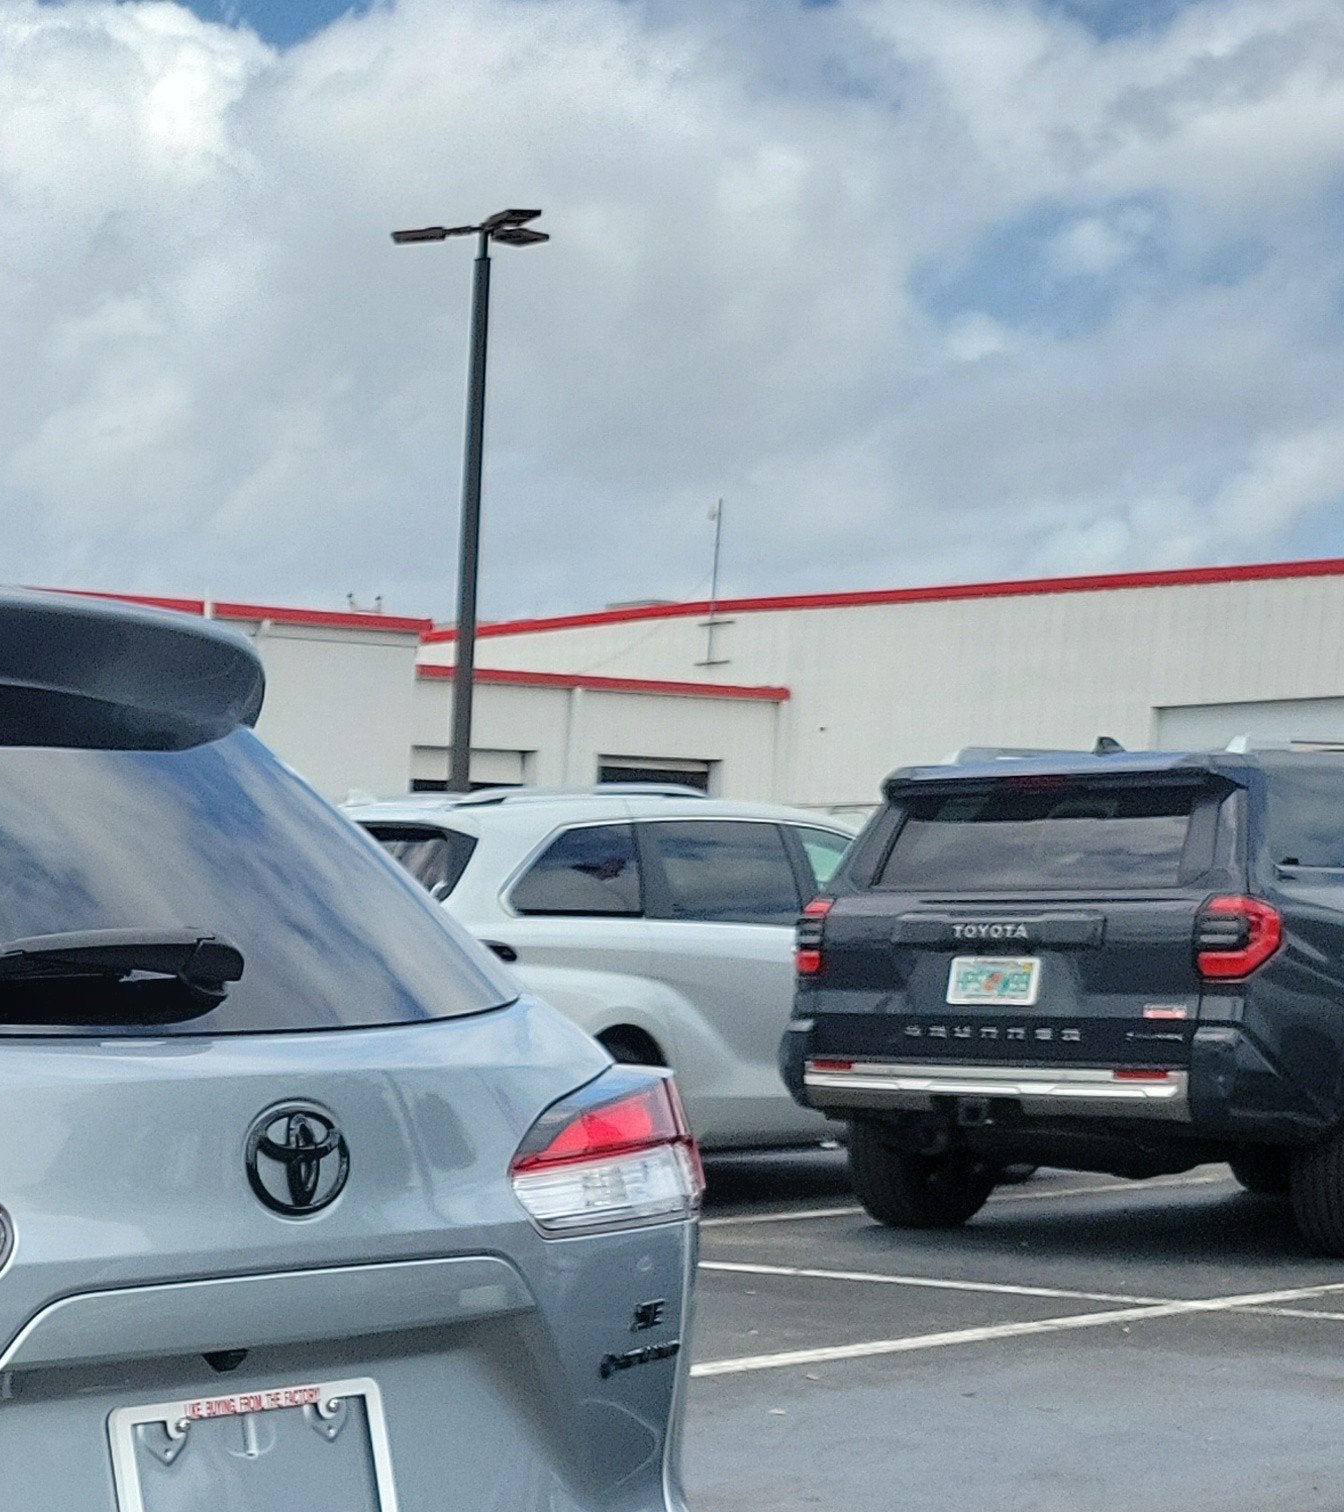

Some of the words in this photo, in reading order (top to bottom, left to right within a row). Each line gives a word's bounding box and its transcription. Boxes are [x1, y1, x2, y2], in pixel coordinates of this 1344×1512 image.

[952, 923, 1029, 939] TOYOTA
[239, 1395, 263, 1411] FROM
[266, 1392, 281, 1408] THE
